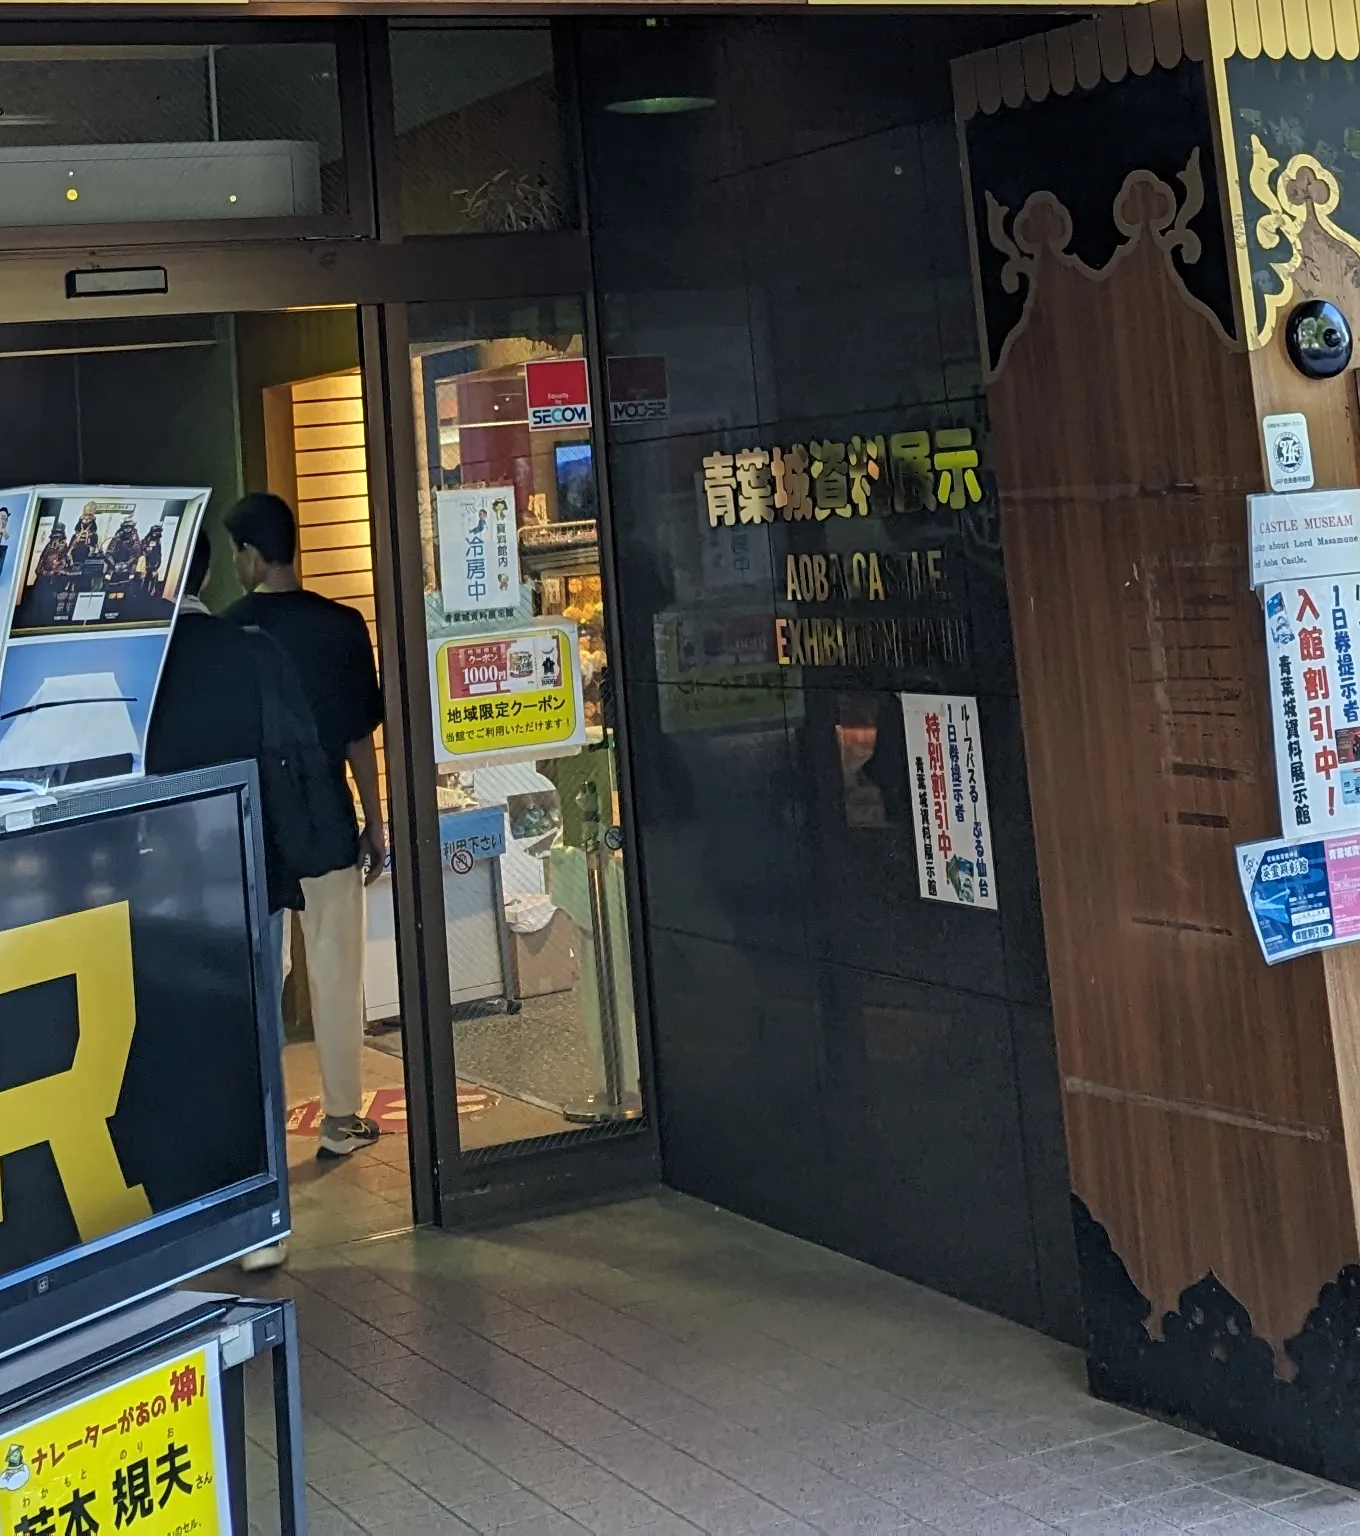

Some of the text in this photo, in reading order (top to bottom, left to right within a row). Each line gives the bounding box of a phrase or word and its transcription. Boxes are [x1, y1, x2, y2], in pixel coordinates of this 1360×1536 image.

[532, 406, 587, 425] SECOM
[1259, 520, 1298, 535] CASTLE
[1304, 515, 1354, 530] MUSEAM
[1269, 542, 1289, 551] about
[1294, 539, 1313, 548] Lord
[1317, 535, 1358, 546] Masamune
[465, 536, 486, 602] 冷房中
[1331, 585, 1359, 723] 1日券提示者
[447, 695, 566, 723] 地域限定クーポン
[1296, 588, 1338, 816] 入館割引中！
[1278, 654, 1311, 826] 青葉城資料展示館
